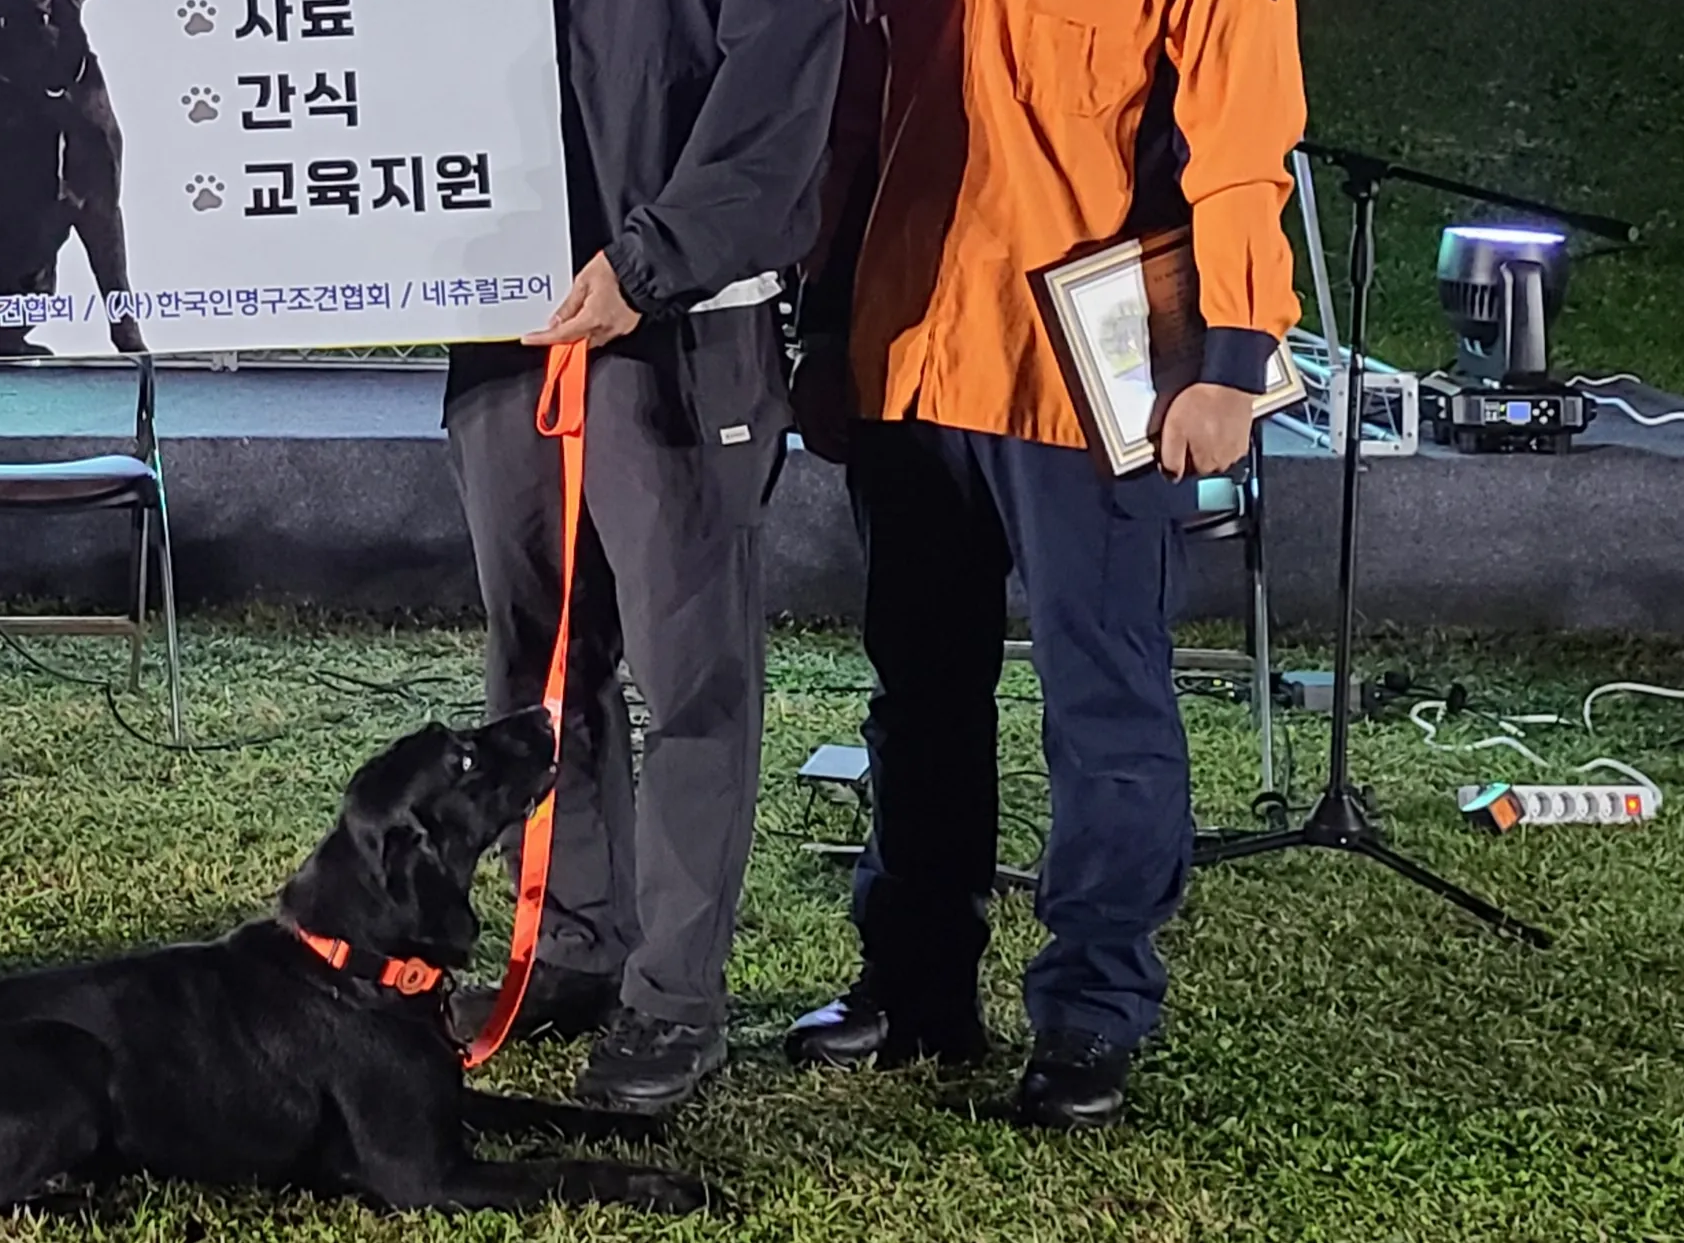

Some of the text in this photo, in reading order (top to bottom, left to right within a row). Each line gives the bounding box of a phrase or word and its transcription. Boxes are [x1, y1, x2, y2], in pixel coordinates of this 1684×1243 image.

[237, 71, 359, 129] 간식
[242, 153, 492, 217] 교육지원
[422, 274, 553, 307] 네츄럴코어
